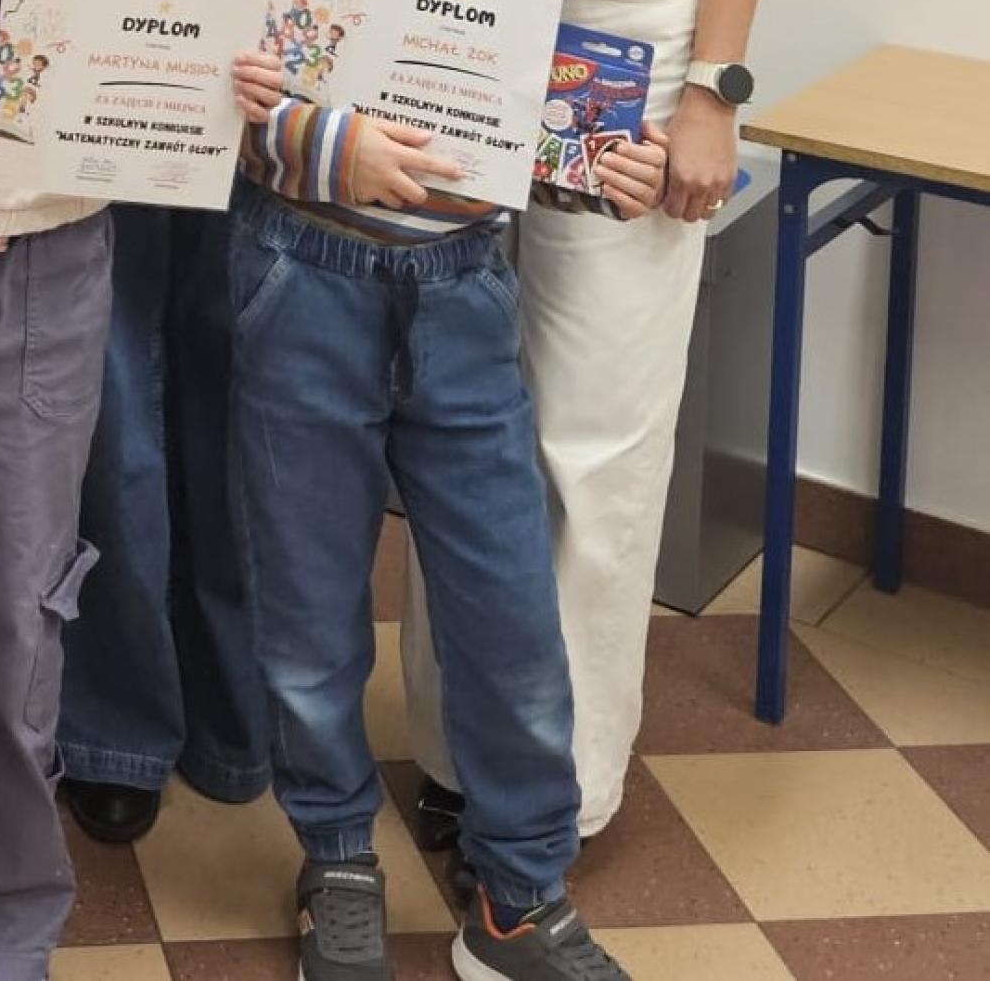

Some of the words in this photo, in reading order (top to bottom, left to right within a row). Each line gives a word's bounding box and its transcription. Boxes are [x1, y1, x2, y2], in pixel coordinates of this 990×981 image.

[122, 17, 200, 39] DYPLOM
[87, 53, 160, 71] MARTYNA
[551, 64, 589, 82] UNO
[380, 91, 389, 100] W
[392, 93, 444, 114] SZKOLNYM
[446, 106, 502, 128] KONKURSIE
[83, 116, 93, 125] W
[96, 115, 149, 130] SZKOLNYM
[150, 121, 205, 136] KONKURSIE
[440, 124, 482, 143] ZAWRÓT
[144, 139, 186, 153] ZAWRÓT
